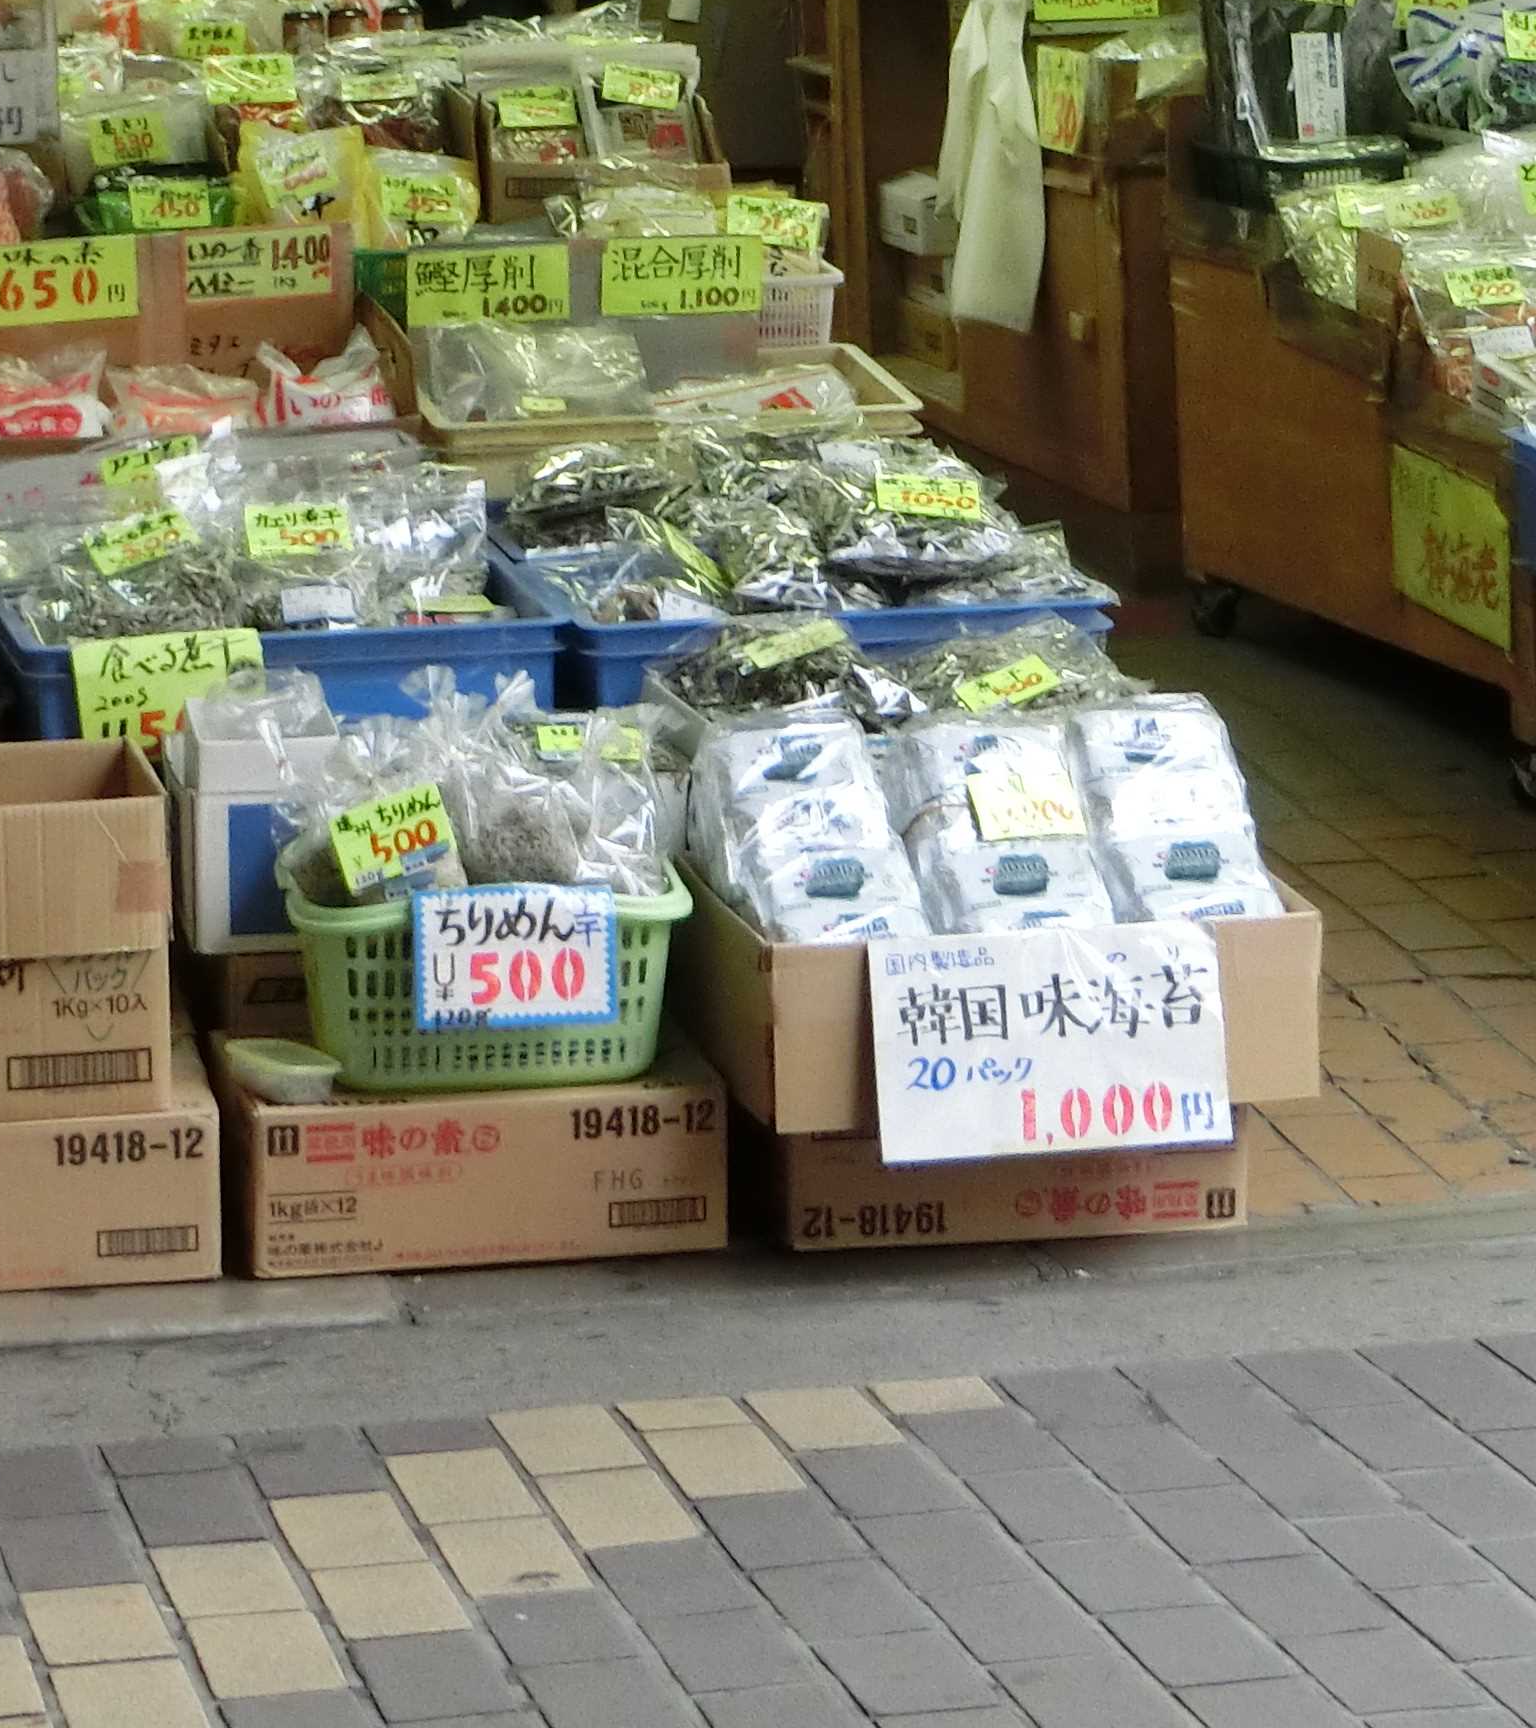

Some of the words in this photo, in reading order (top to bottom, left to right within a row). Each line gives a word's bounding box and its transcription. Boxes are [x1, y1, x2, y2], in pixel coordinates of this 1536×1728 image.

[414, 254, 536, 297] 鰹厚削
[612, 244, 742, 283] 混合厚削
[375, 791, 441, 829] ちりめん
[368, 817, 438, 864] 500
[437, 901, 575, 947] ちりめん
[896, 970, 1209, 1045] 韓国味海苔
[570, 1104, 715, 1141] 19418-12
[1019, 1081, 1217, 1148] 1,000円
[53, 1127, 204, 1169] 19418-12
[800, 1201, 948, 1239] 19418-12
